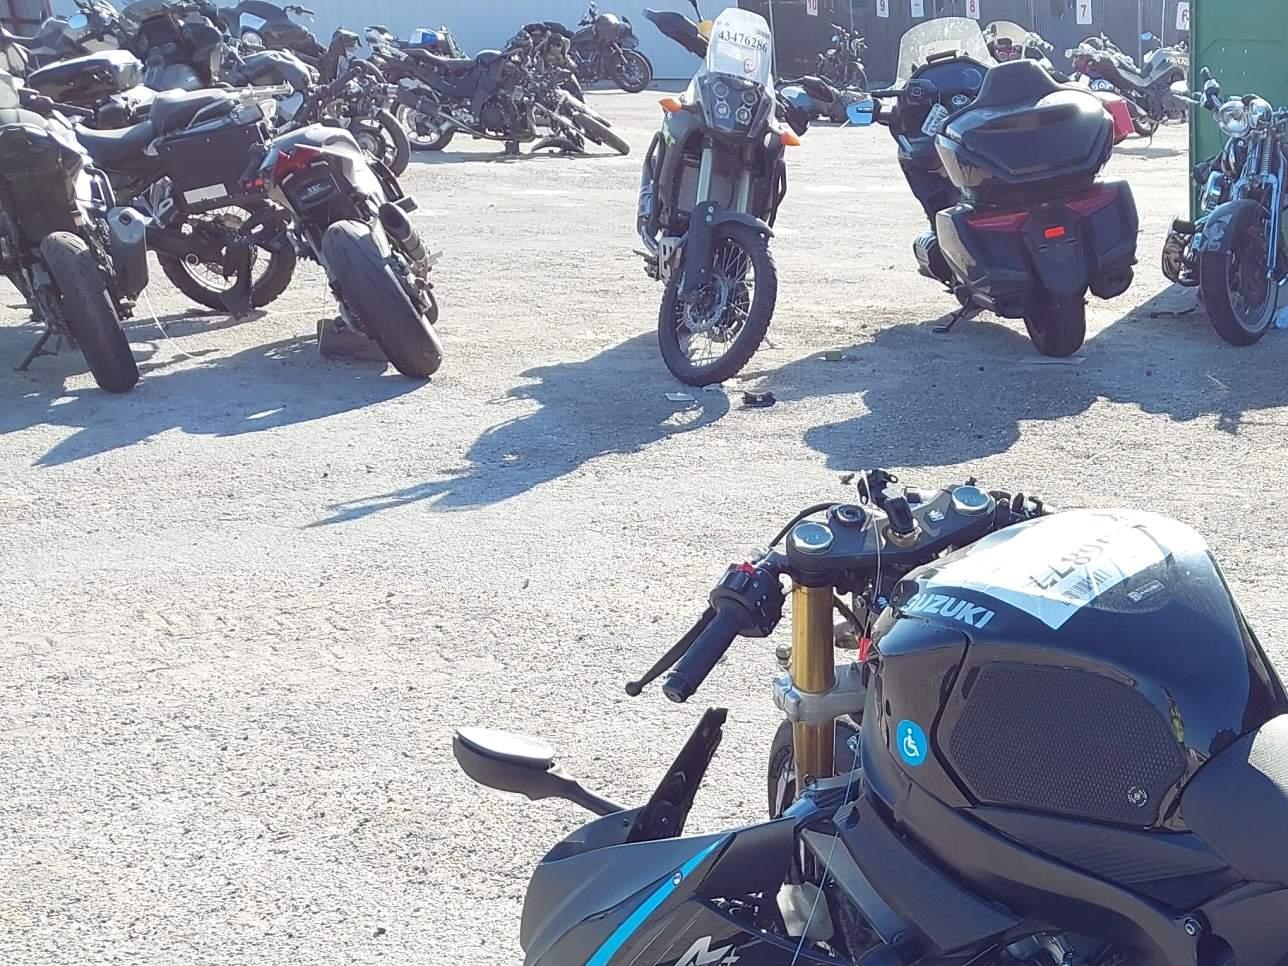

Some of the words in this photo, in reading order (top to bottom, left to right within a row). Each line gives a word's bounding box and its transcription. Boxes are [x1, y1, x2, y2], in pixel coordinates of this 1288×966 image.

[880, 0, 886, 12] 9
[969, 0, 976, 13] 8
[1080, 4, 1087, 18] 7
[718, 30, 768, 54] 43476286
[901, 593, 996, 629] SUZUKI
